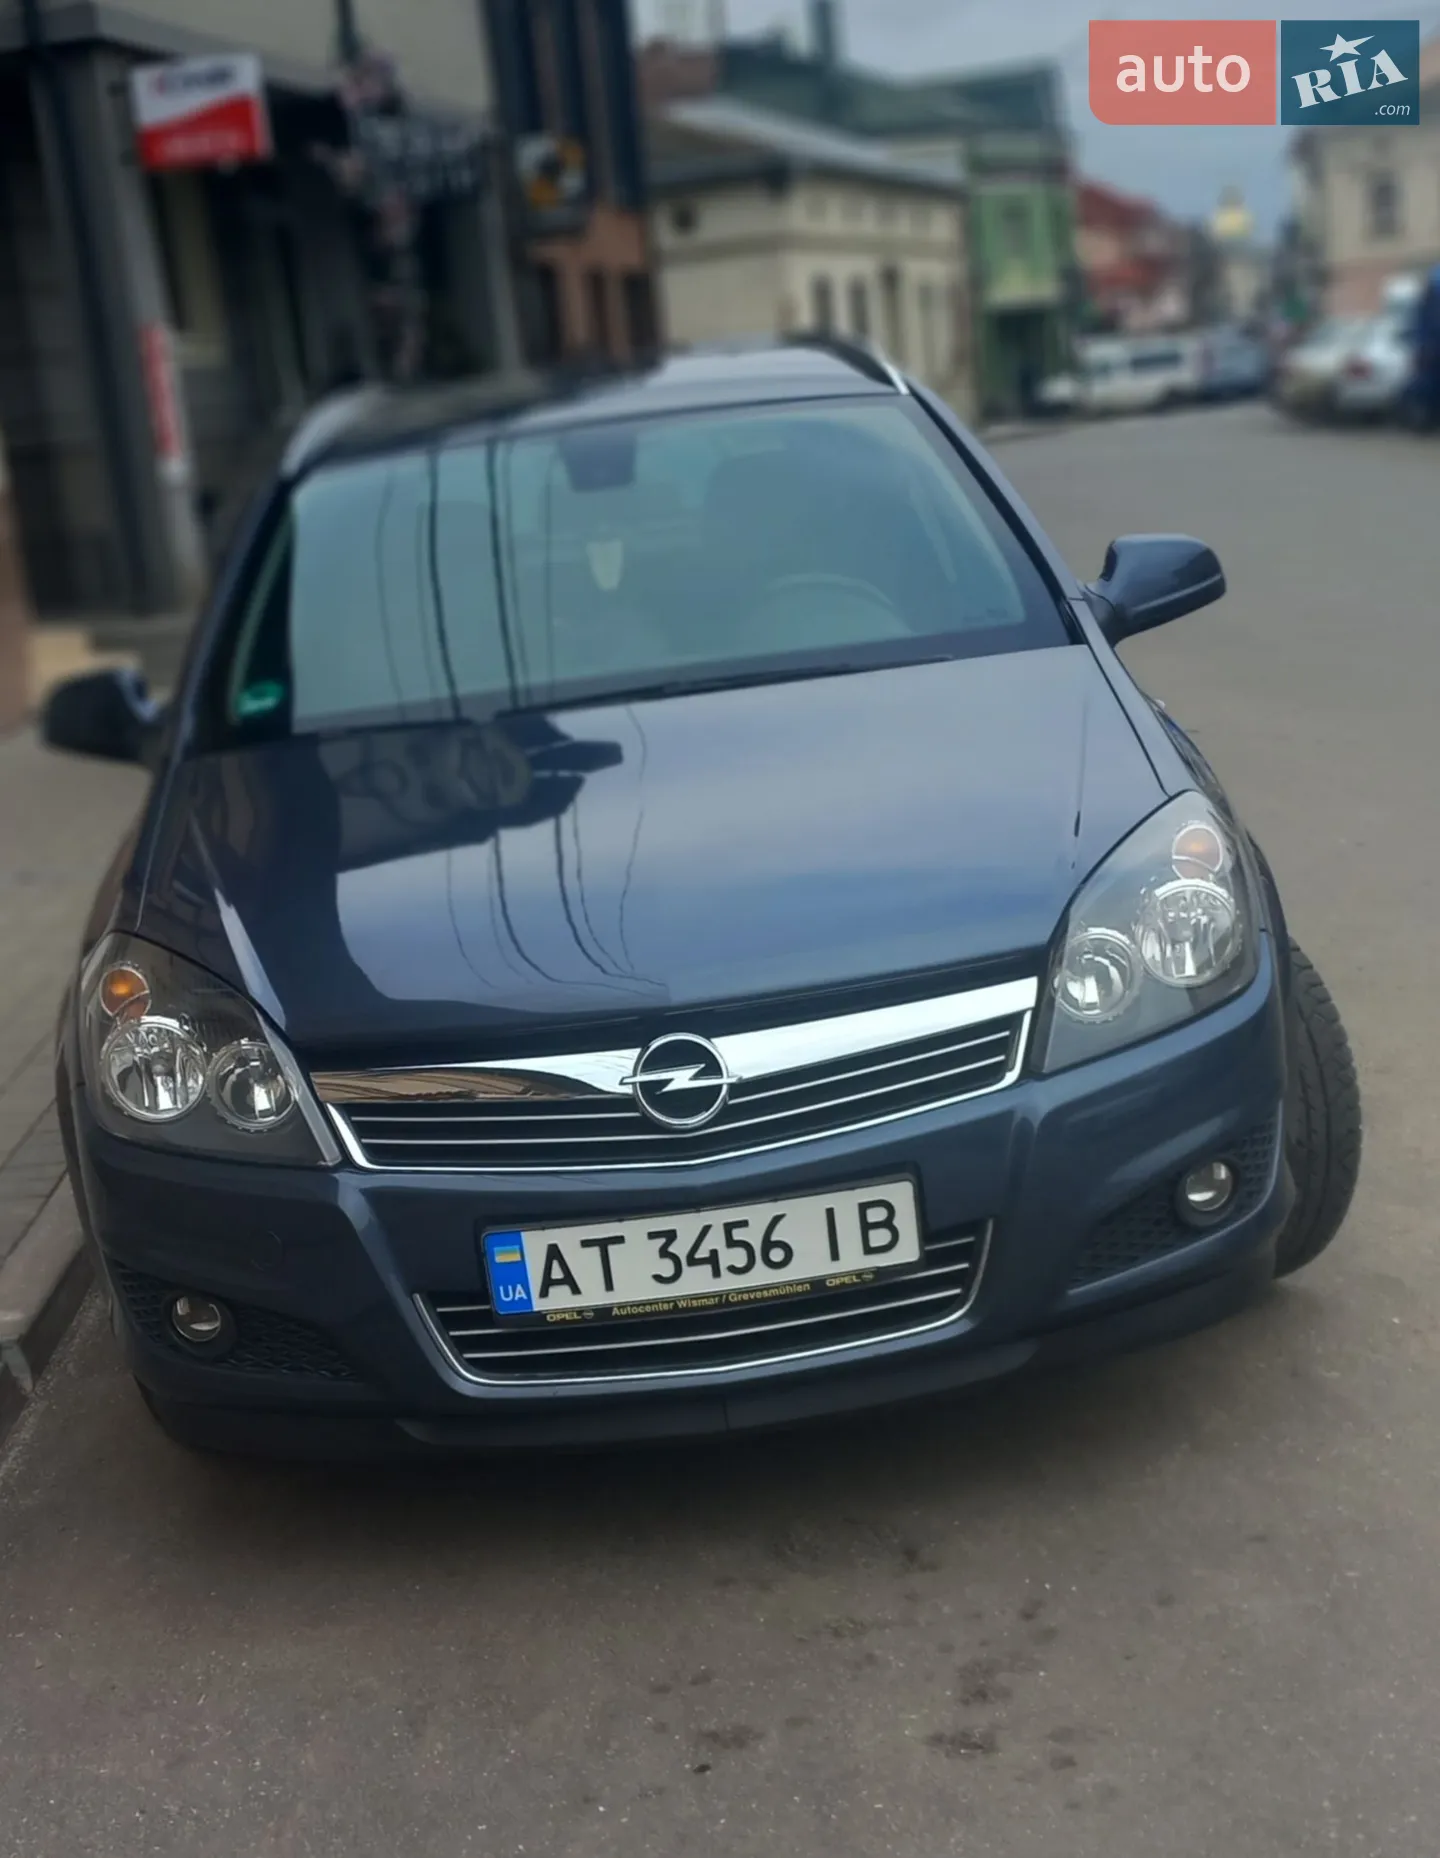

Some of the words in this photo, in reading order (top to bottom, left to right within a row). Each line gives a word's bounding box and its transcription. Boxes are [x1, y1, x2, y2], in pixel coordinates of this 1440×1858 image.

[538, 1234, 626, 1299] AT
[646, 1212, 794, 1286] 3456
[824, 1198, 900, 1263] IB
[499, 1284, 528, 1302] UA
[546, 1311, 583, 1323] OPEL
[611, 1301, 675, 1317] Autocenter
[678, 1296, 721, 1309] Wismar
[728, 1282, 811, 1303] Grevesmühlen
[825, 1274, 861, 1288] OPEL
